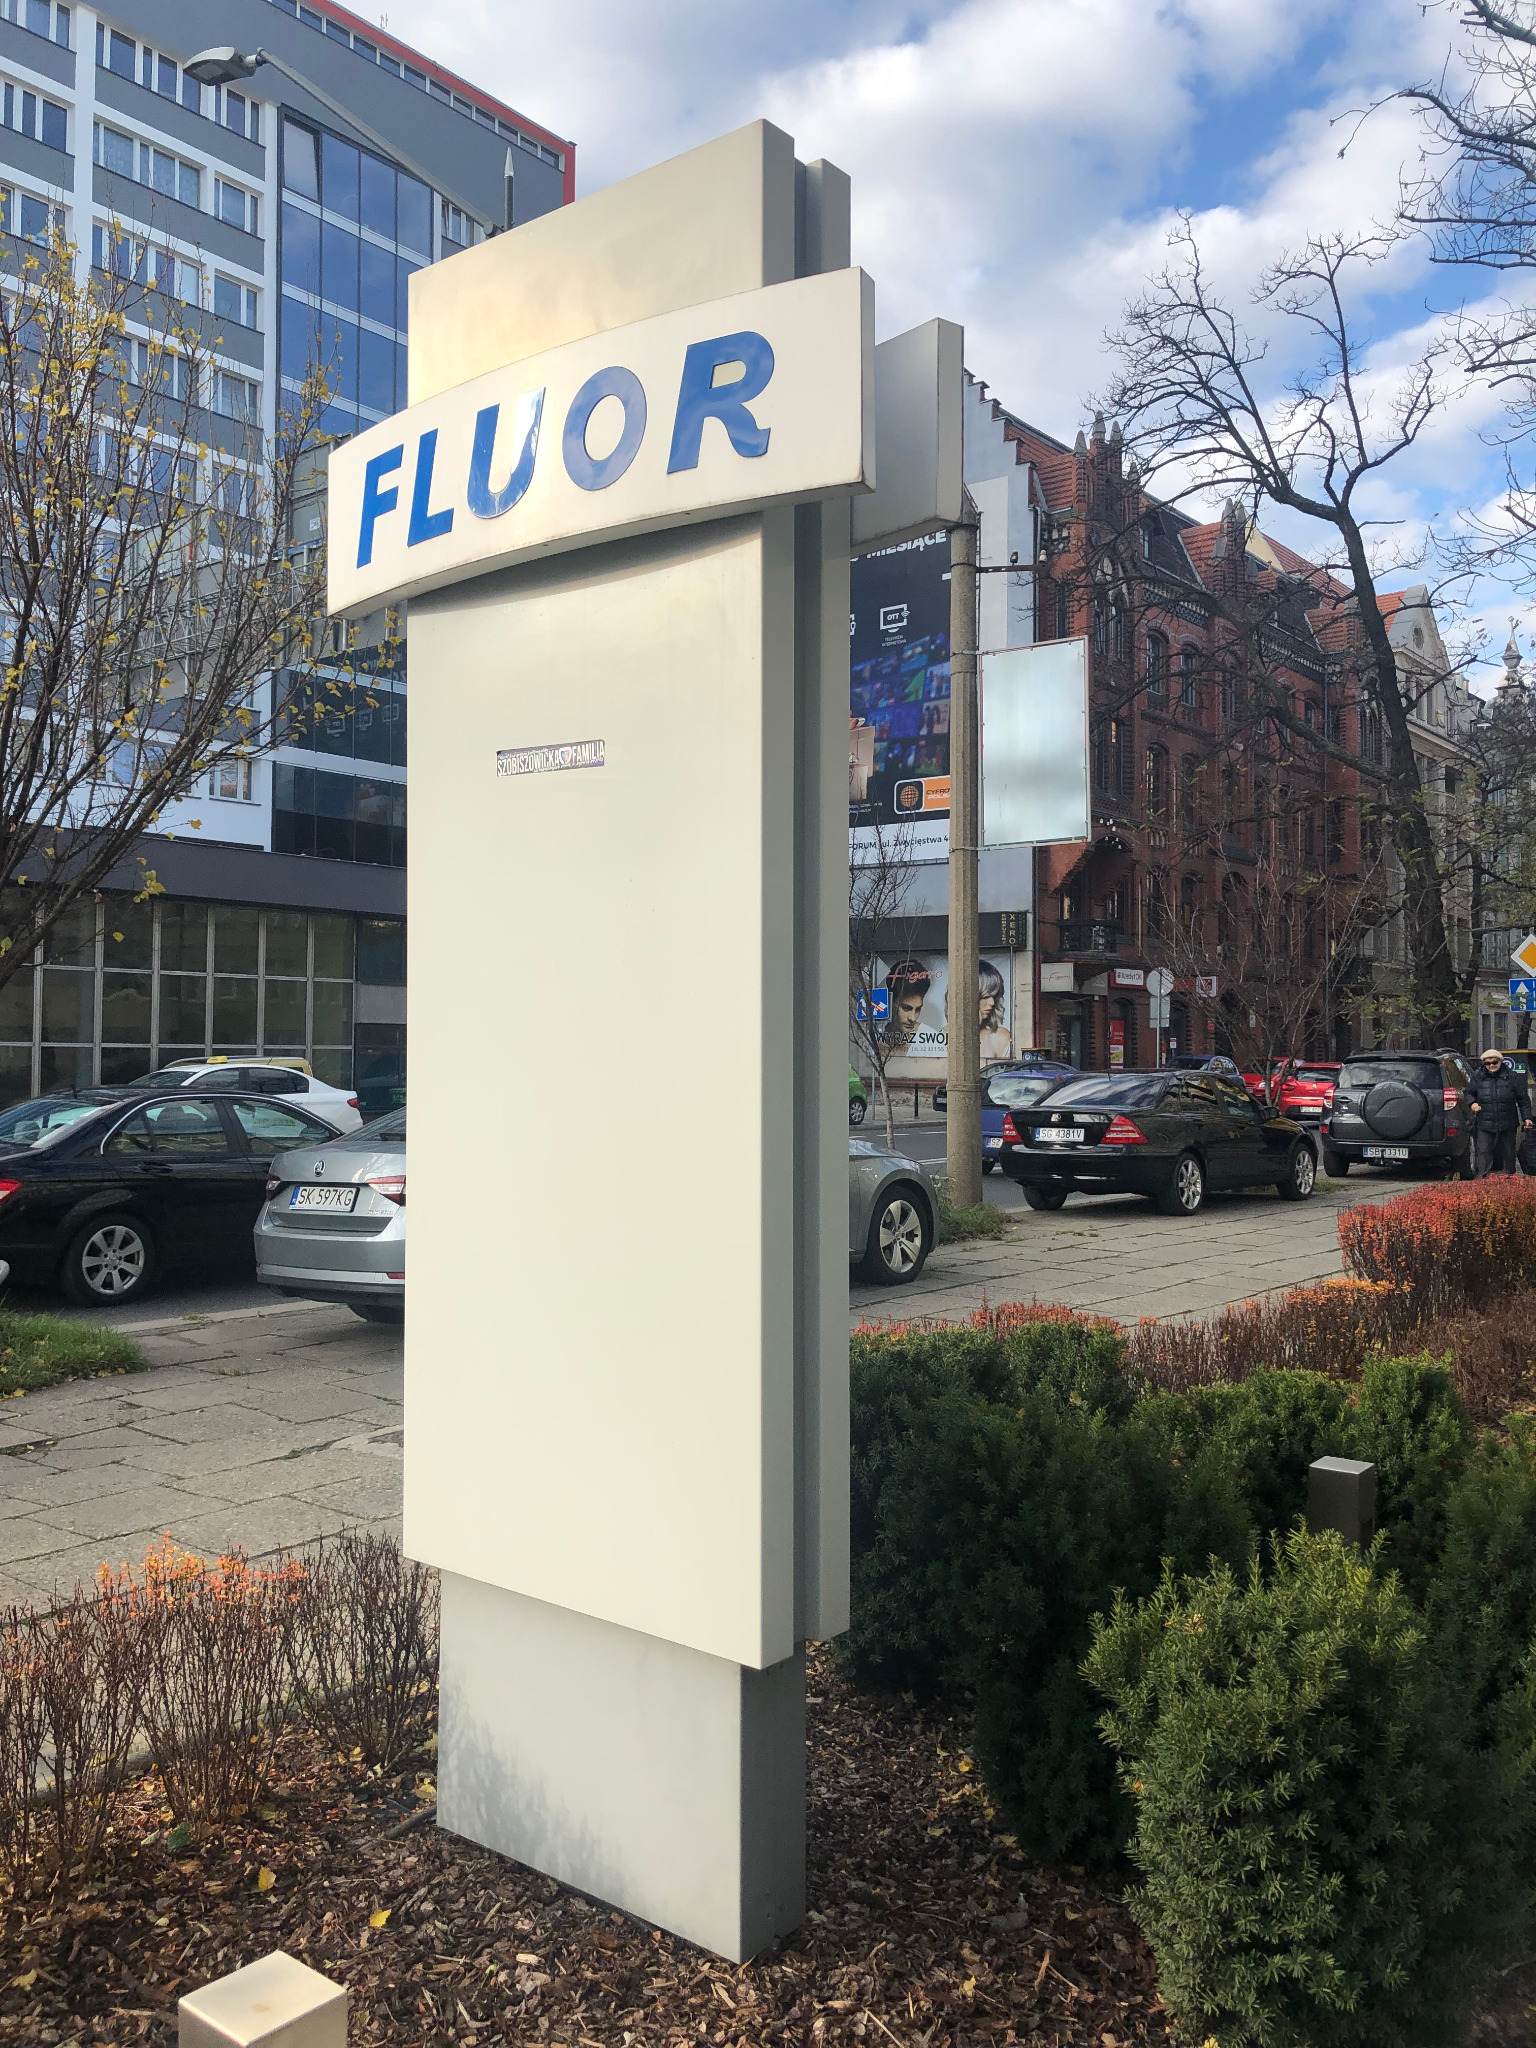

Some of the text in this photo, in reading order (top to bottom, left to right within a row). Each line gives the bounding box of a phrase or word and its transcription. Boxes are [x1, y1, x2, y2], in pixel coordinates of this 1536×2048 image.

[356, 331, 774, 569] FLUOR
[887, 612, 900, 621] OTT
[572, 740, 605, 764] FAMILIA
[919, 1029, 948, 1046] SWÓJ
[1041, 1129, 1083, 1139] SG 4381V
[298, 1188, 354, 1206] SK 597KG
